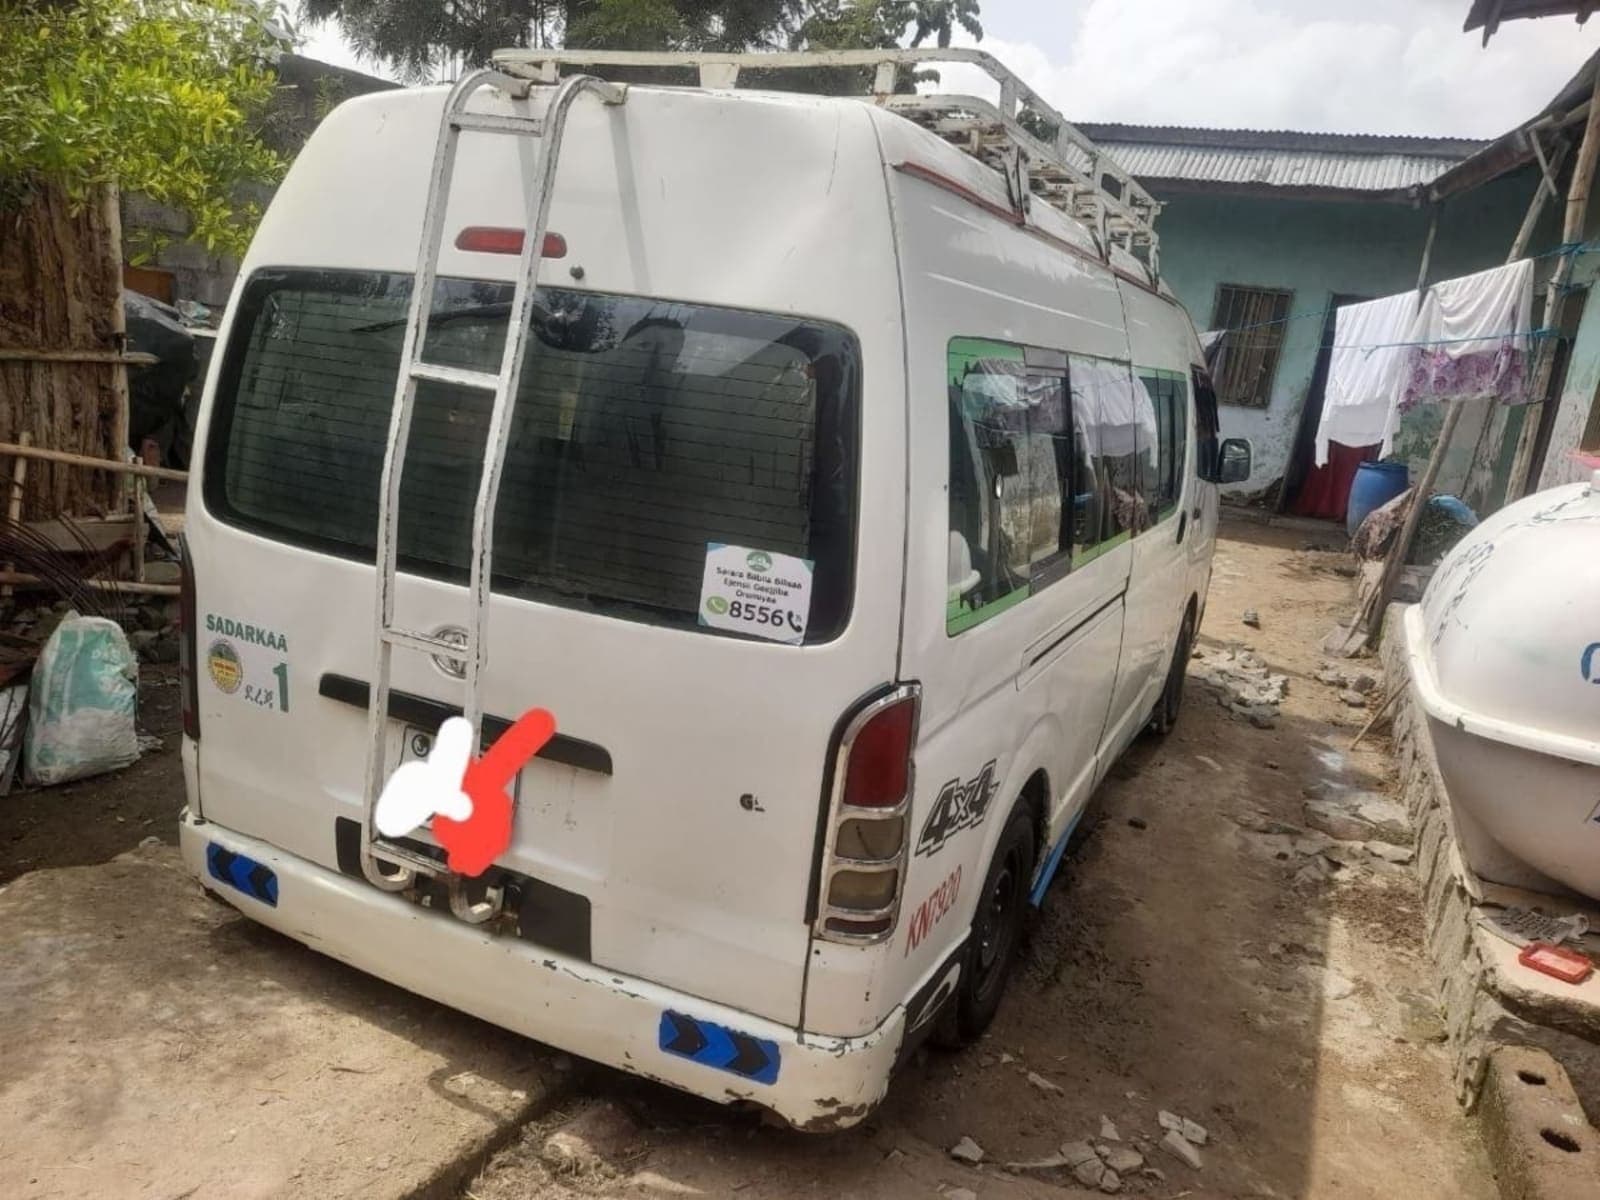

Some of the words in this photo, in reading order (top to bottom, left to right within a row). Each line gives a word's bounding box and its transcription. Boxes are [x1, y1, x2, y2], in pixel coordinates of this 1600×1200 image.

[206, 613, 288, 652] SADARKAA
[729, 601, 784, 627] 8556
[272, 662, 289, 713] 1
